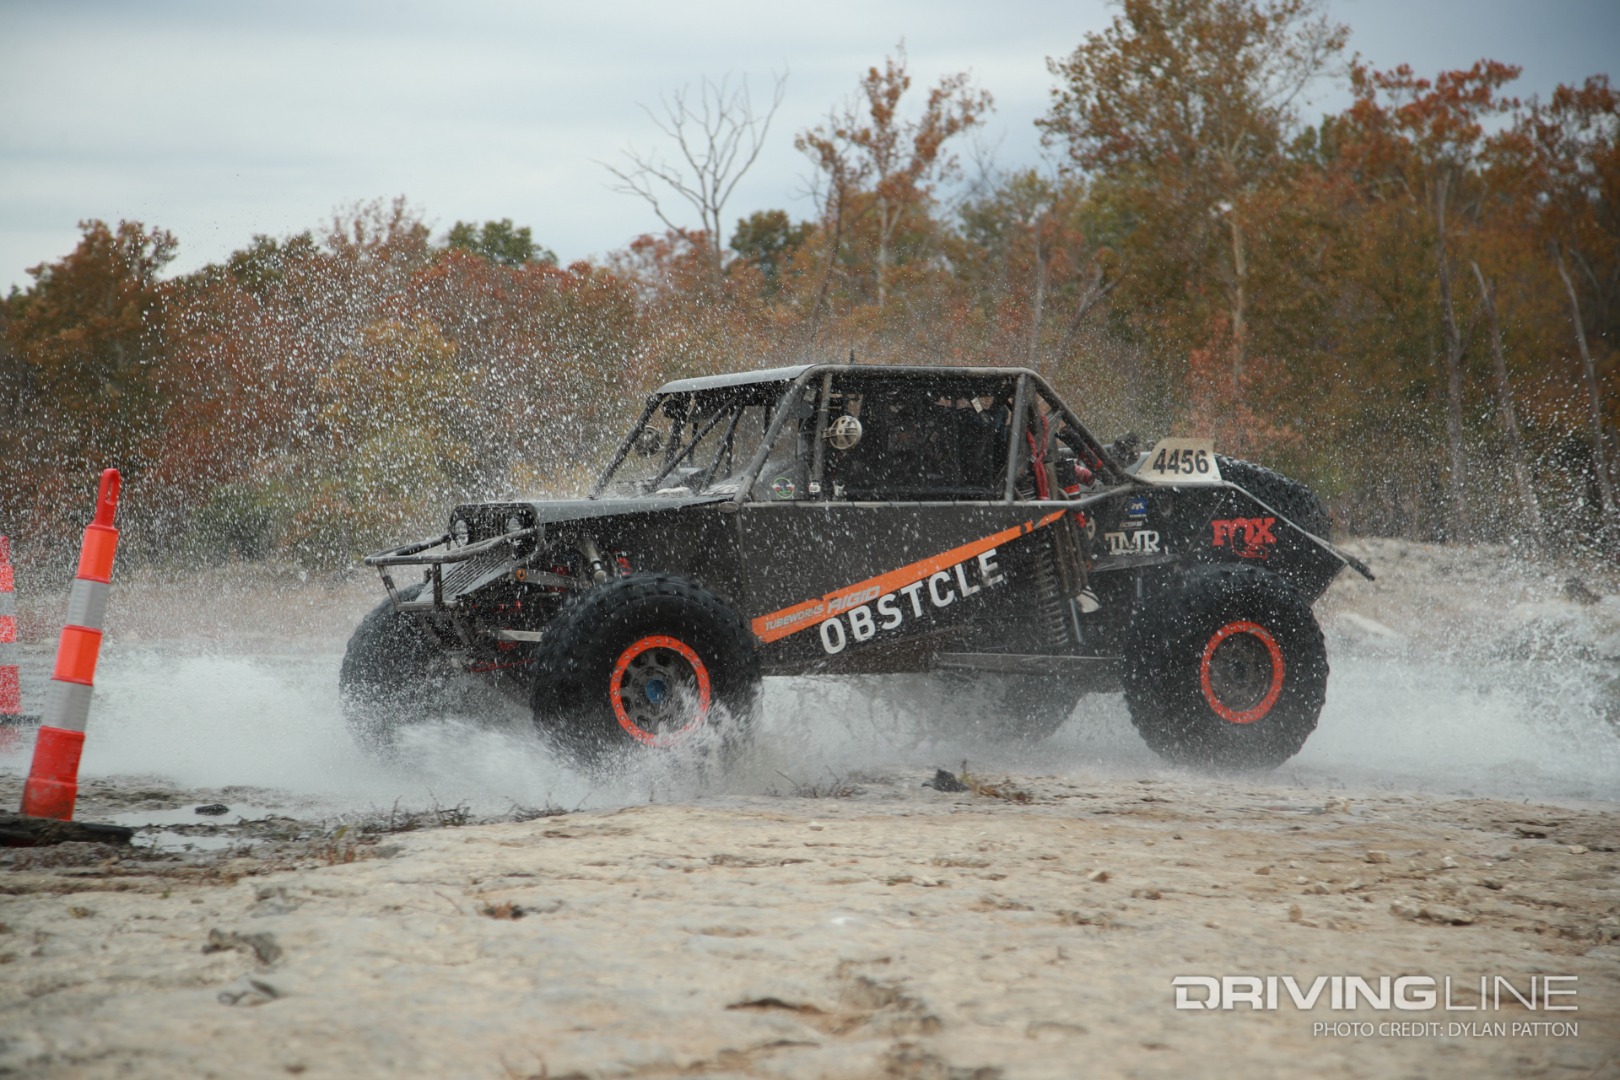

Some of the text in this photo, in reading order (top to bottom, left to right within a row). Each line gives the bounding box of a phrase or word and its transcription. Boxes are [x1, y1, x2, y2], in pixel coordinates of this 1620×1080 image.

[1153, 448, 1209, 475] 4456
[1104, 530, 1160, 555] TMR
[1211, 517, 1277, 559] FOX
[765, 585, 881, 631] TUBEWORKS RIGID
[819, 549, 1004, 655] OBSTCLE
